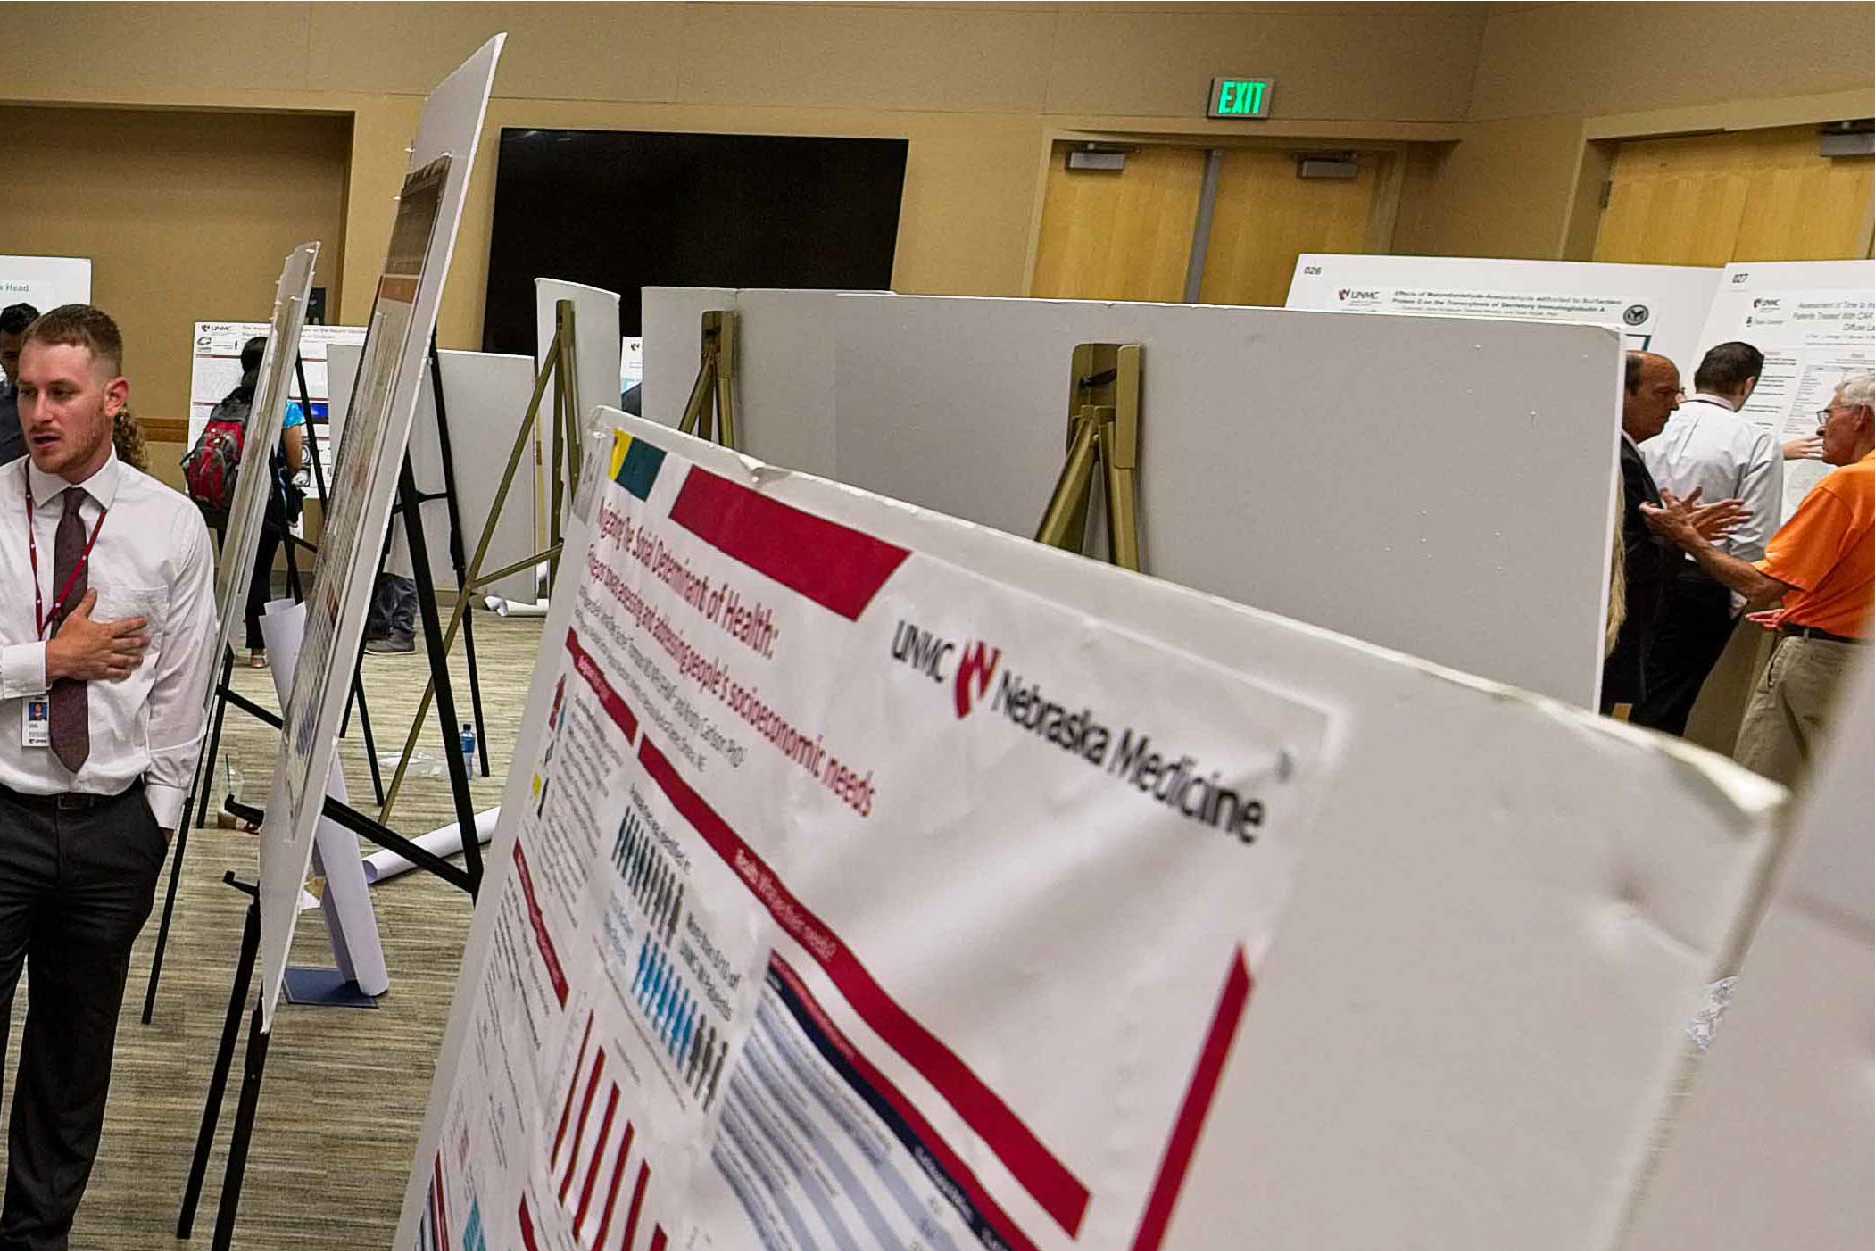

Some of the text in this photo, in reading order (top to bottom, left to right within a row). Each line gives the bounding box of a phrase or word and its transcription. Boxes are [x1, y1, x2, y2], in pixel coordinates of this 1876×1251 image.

[1218, 80, 1267, 114] EXIT
[651, 539, 710, 613] Determinant
[706, 582, 729, 625] of
[721, 585, 779, 661] Health:
[727, 682, 826, 779] socioeconomic
[821, 757, 876, 818] needs
[890, 618, 1266, 845] UNMC Nebraska Medicine
